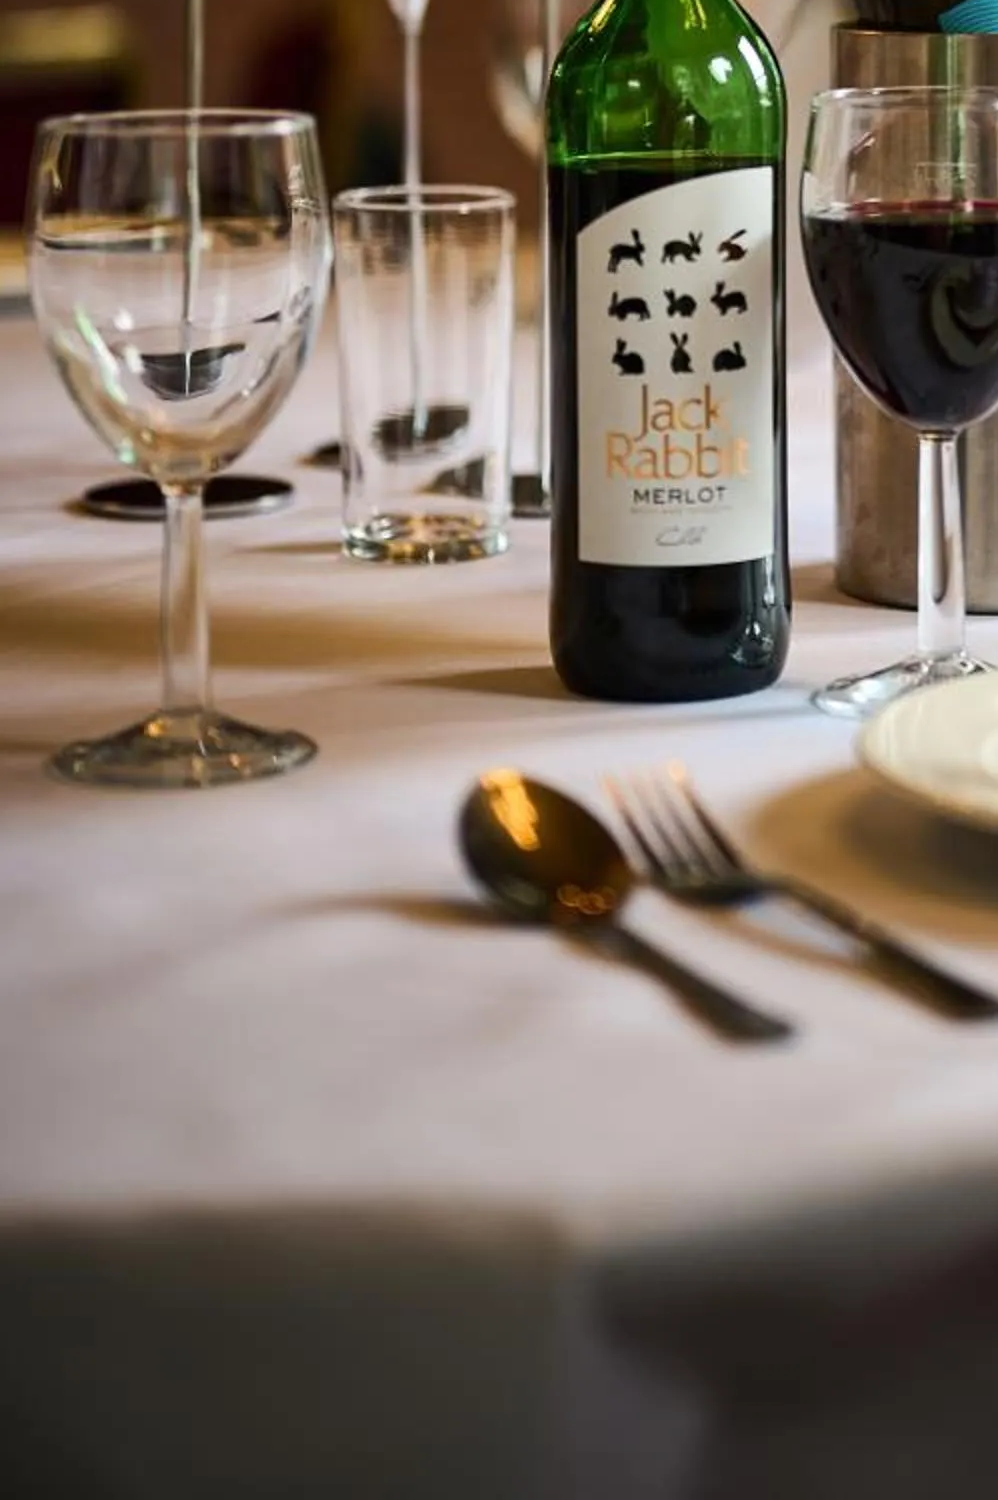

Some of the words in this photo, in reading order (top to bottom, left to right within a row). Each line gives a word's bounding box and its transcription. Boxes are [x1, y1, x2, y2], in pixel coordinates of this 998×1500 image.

[634, 383, 729, 442] Jack
[605, 431, 749, 480] Rabbit
[632, 485, 727, 505] MERLOT
